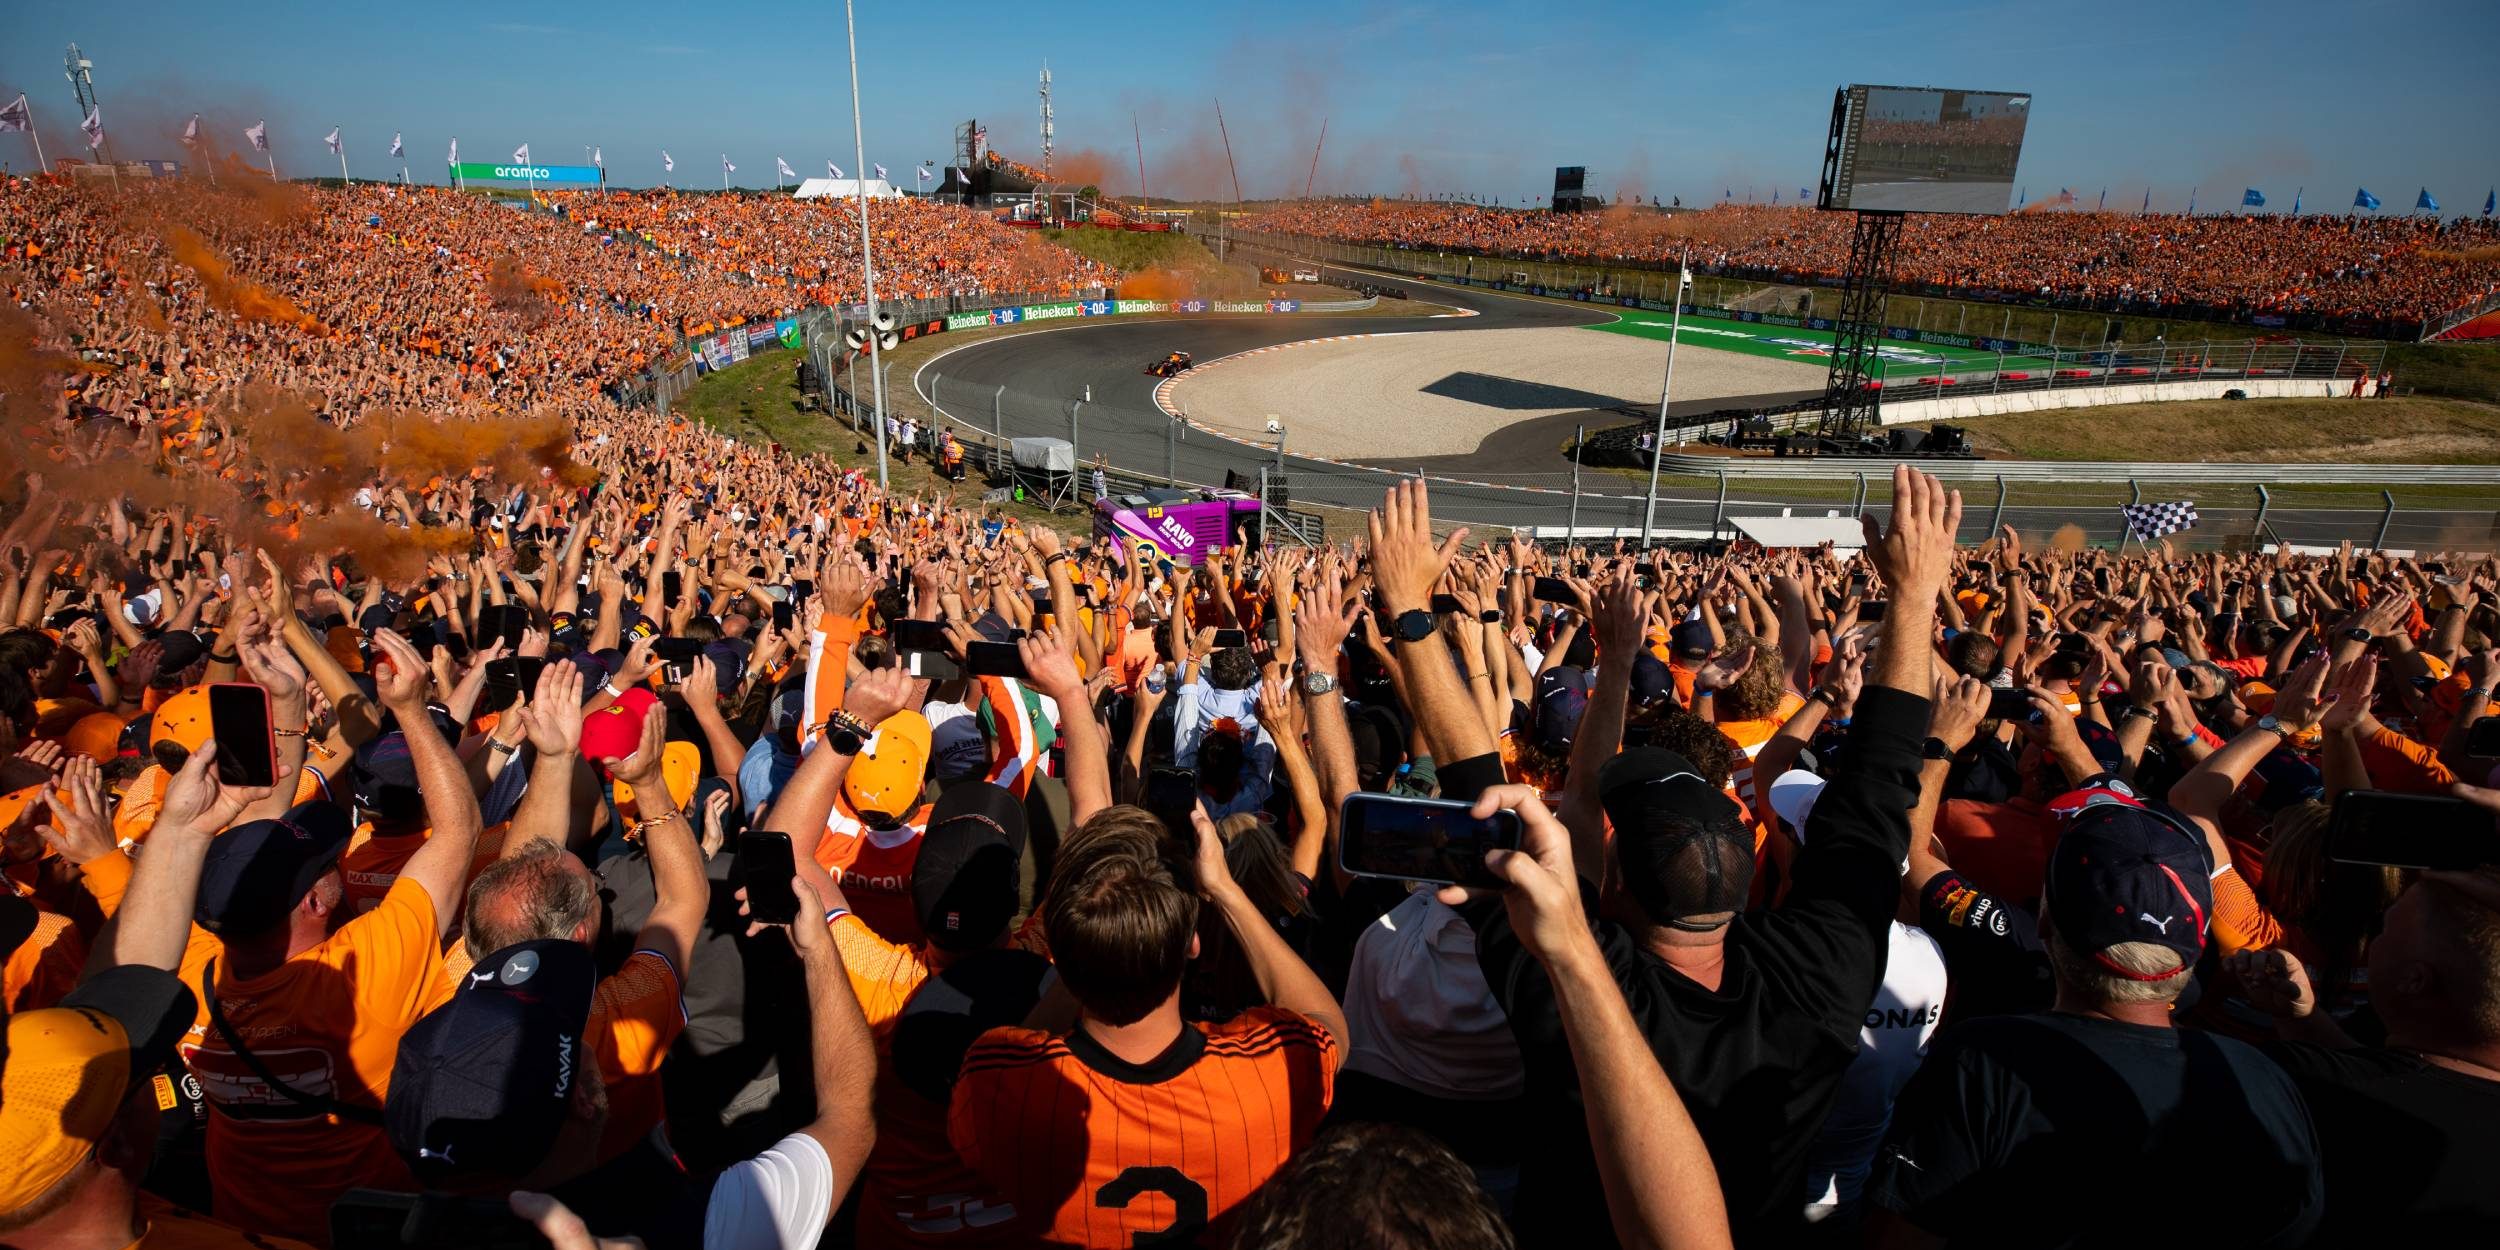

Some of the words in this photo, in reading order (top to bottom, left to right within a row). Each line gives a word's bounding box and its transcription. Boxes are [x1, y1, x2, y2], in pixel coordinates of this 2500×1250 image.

[495, 166, 549, 179] aramco
[1025, 306, 1073, 320] Heineken
[1118, 301, 1169, 313] Heineken
[1215, 301, 1263, 313] Heineken
[1640, 300, 1669, 312] Heineken
[1696, 306, 1730, 319] Heineken
[949, 314, 987, 330] Heineken
[1761, 314, 1799, 327] Heineken
[1919, 331, 1969, 348] Heineken
[2019, 343, 2076, 361] Heineen
[1162, 515, 1195, 548] RAVO
[349, 872, 376, 884] MAX
[1971, 897, 1992, 928] citrix
[1864, 1004, 1939, 1029] ONAS
[554, 1033, 573, 1099] KAVAK
